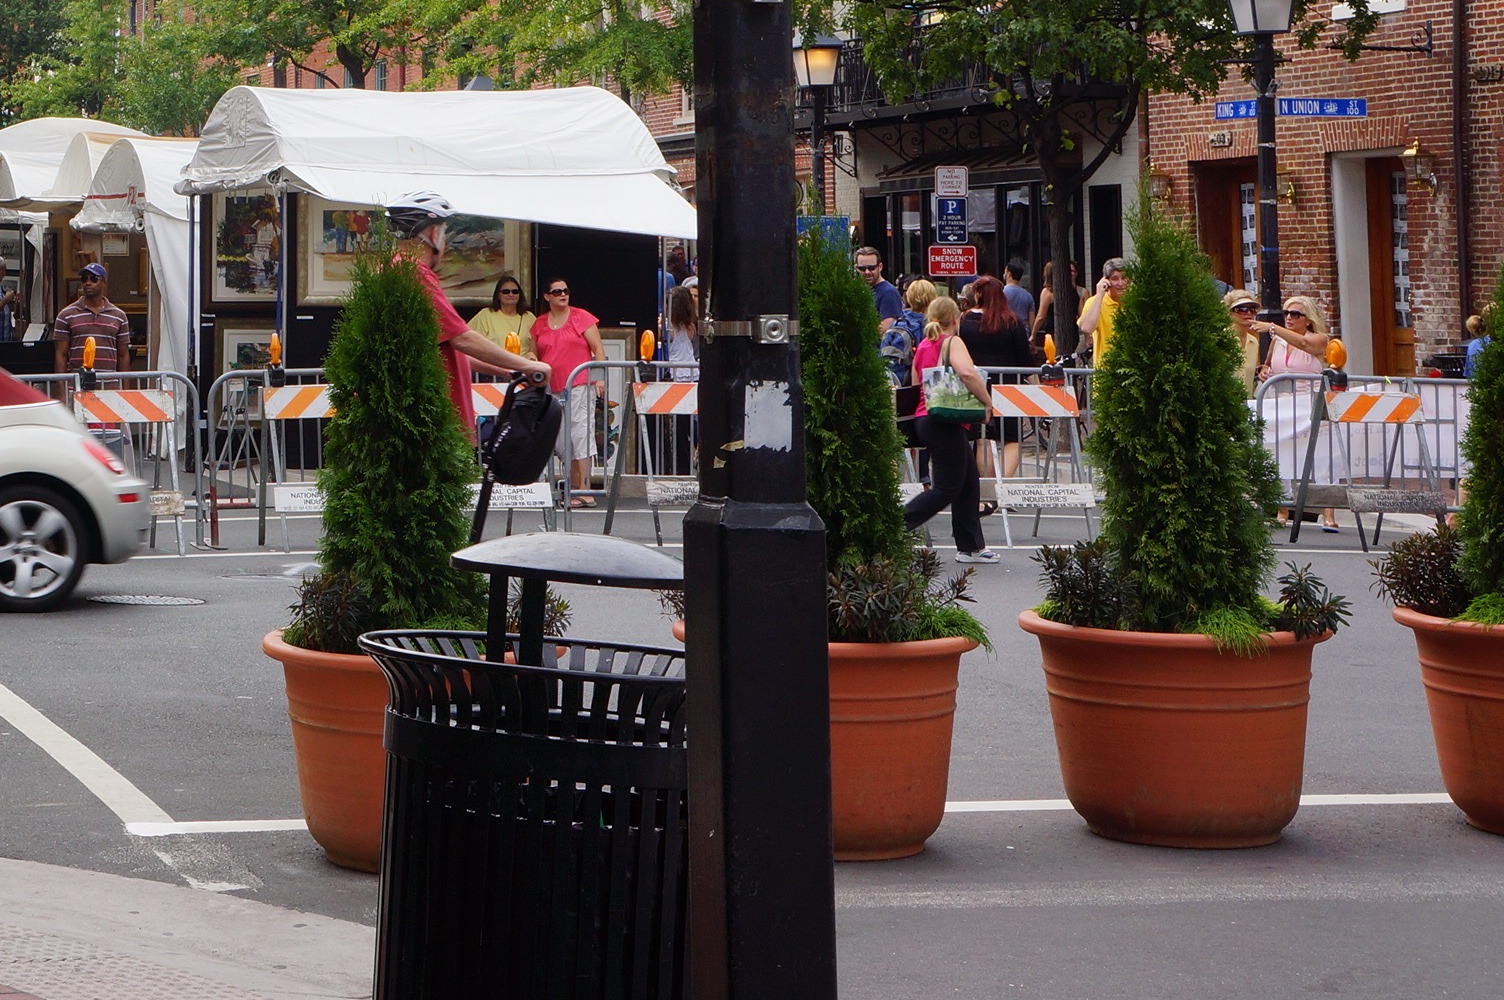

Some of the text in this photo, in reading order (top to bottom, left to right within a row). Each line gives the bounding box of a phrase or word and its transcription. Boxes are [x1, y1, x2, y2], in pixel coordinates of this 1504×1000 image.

[1281, 100, 1320, 115] N UNION
[1348, 100, 1358, 108] ST
[1217, 103, 1234, 118] KING
[1346, 107, 1360, 115] 100
[947, 200, 957, 214] P
[940, 262, 964, 270] ROUTE
